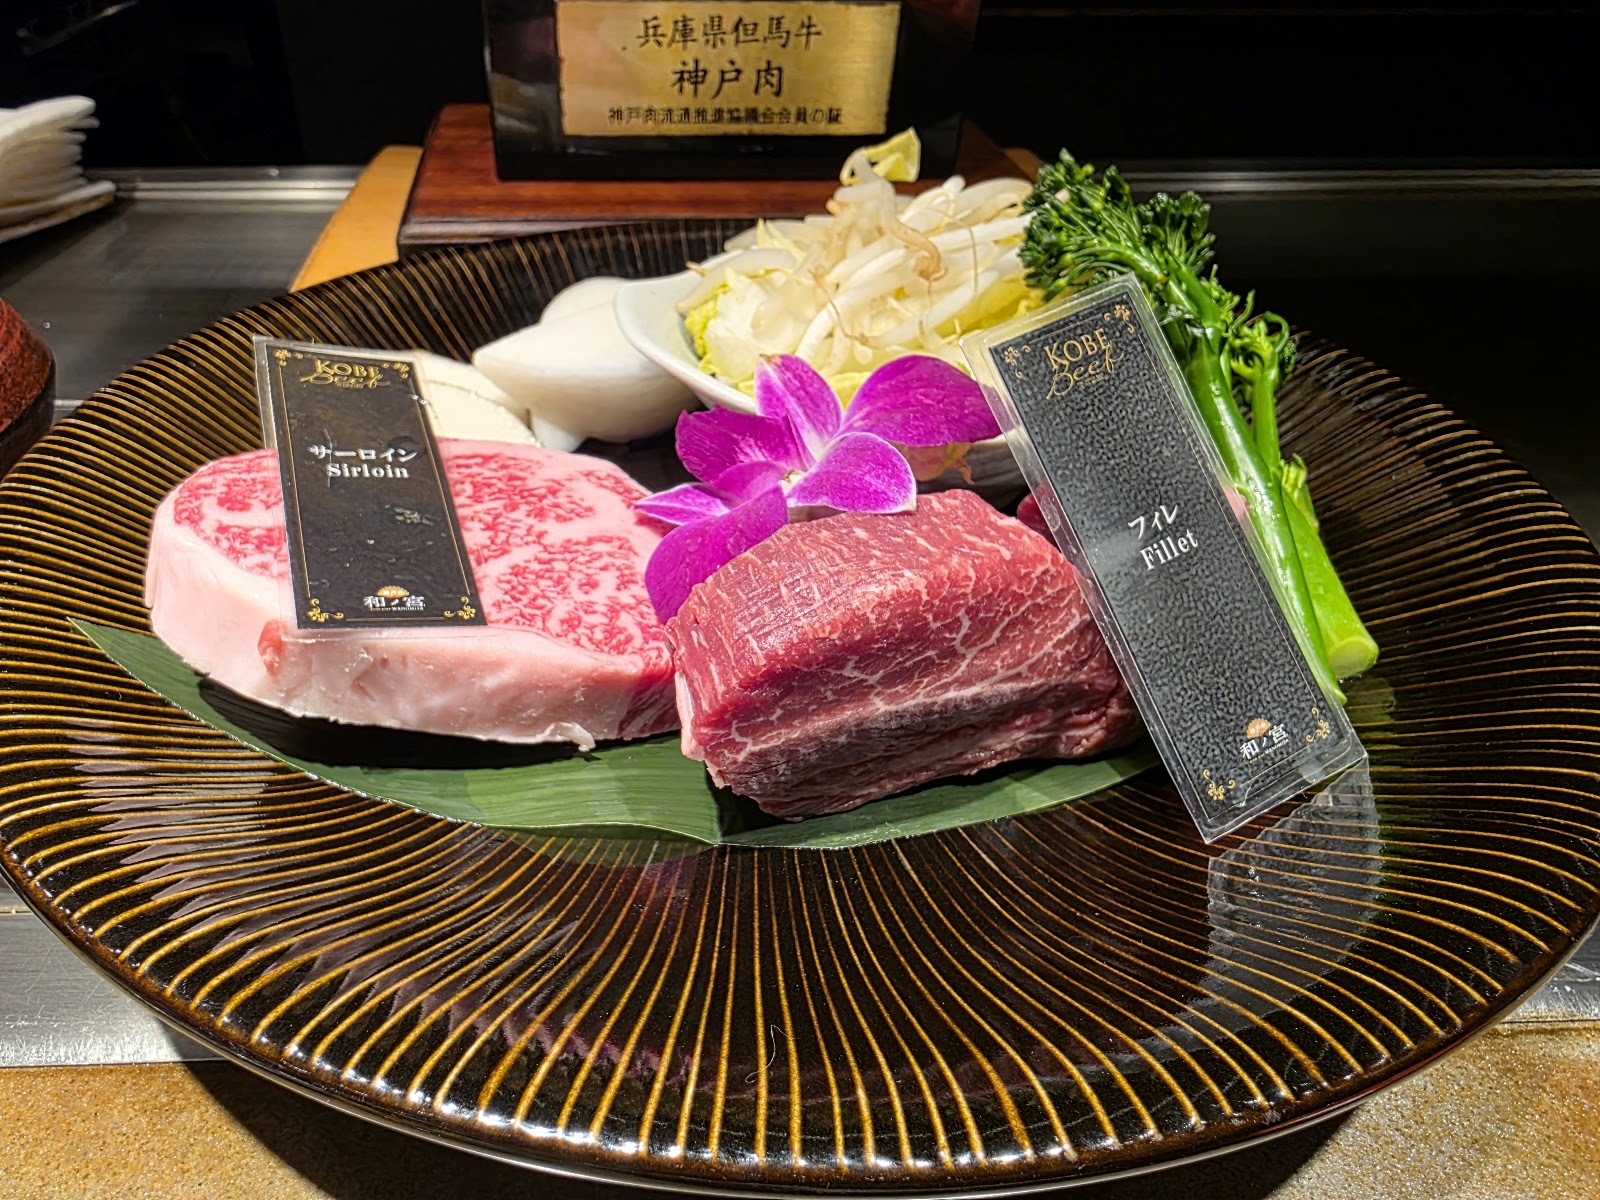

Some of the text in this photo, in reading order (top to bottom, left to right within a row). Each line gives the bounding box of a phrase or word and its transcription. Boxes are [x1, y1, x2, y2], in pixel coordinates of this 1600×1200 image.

[635, 15, 823, 50] 兵庫県但馬牛
[671, 57, 784, 99] 神戸肉
[1043, 327, 1112, 372] KOBE
[314, 359, 380, 379] KOBE
[1045, 340, 1125, 400] Beef
[308, 444, 418, 463] サーロイン
[326, 463, 410, 479] Sirloin
[1127, 504, 1178, 540] フィレ
[1139, 528, 1198, 572] Fillet
[363, 595, 425, 608] 和ノ宮
[1239, 723, 1289, 760] 和ノ宮
